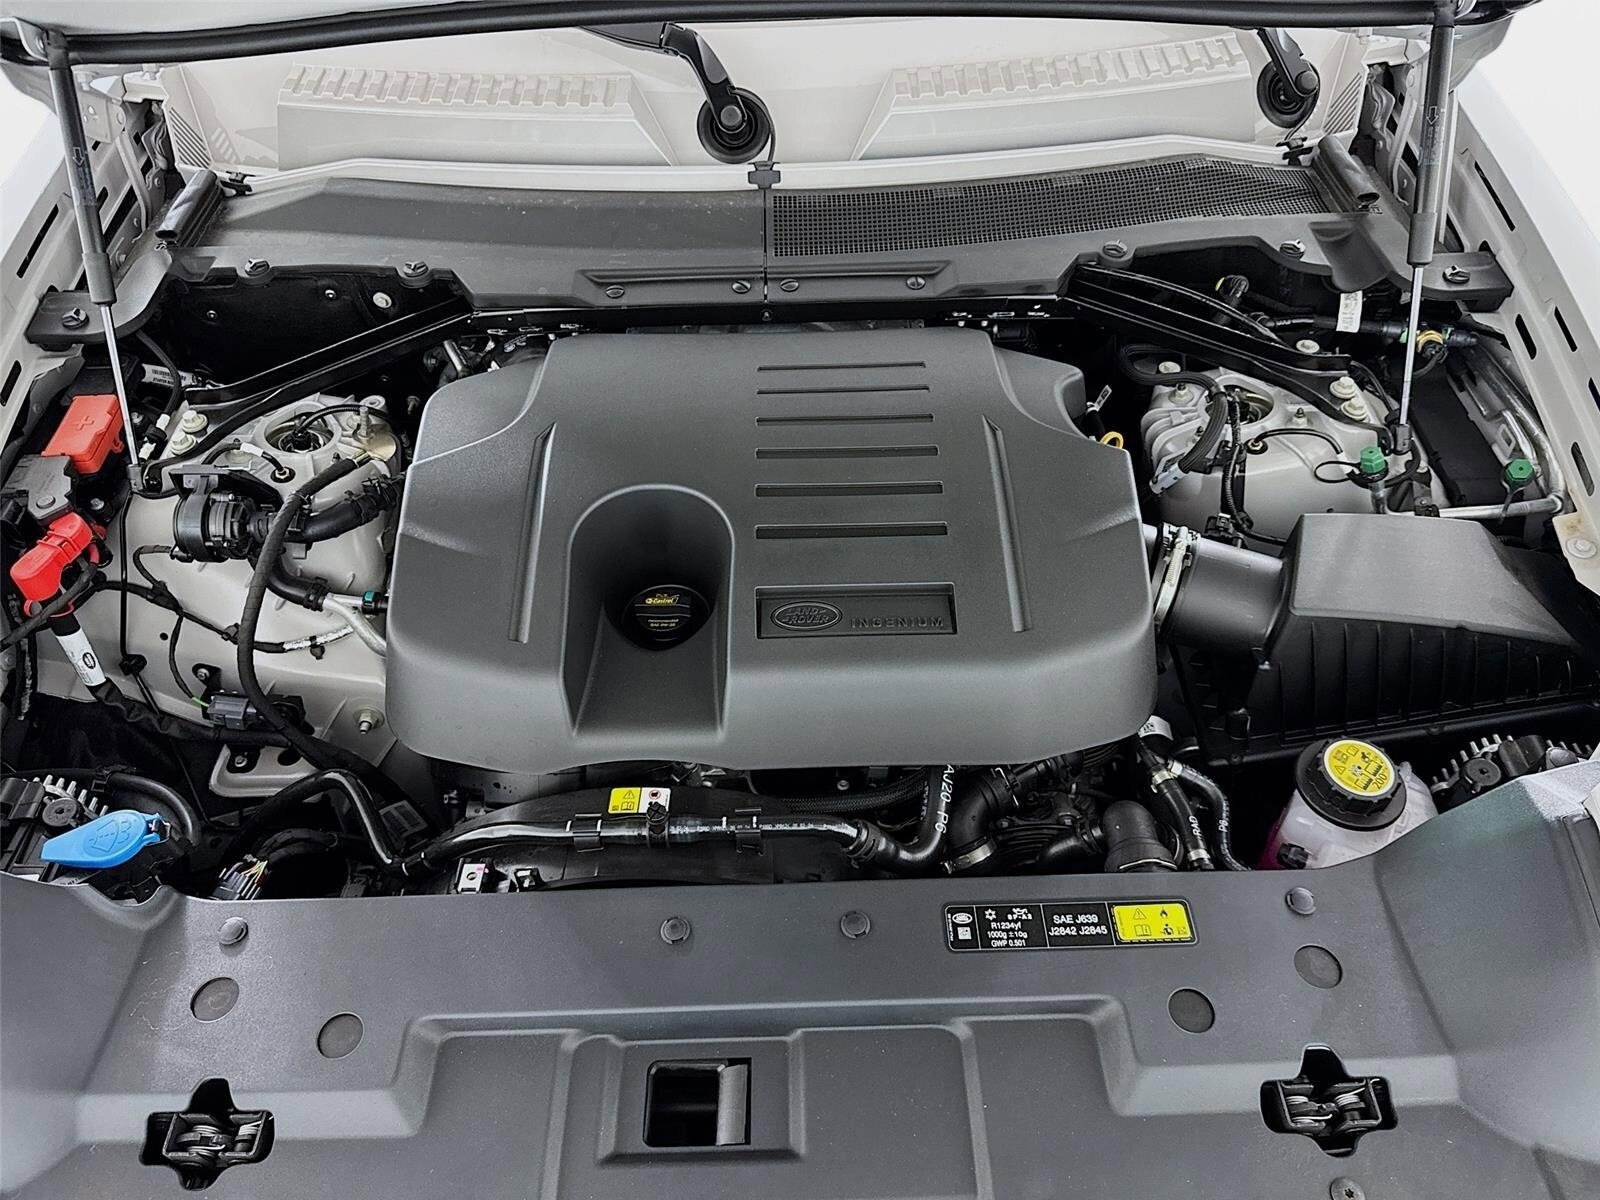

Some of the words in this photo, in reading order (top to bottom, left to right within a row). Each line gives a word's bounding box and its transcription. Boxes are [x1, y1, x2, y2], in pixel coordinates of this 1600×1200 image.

[788, 607, 819, 615] LAND
[789, 616, 829, 624] ROVER
[851, 617, 944, 629] INGENIUM
[1053, 914, 1073, 924] SAE
[1075, 914, 1099, 924] J639
[987, 931, 1008, 939] 1000g
[1048, 926, 1077, 936] J2842
[1079, 925, 1108, 935] J2845
[991, 940, 1007, 948] GWP
[1008, 939, 1026, 947] 0.501
